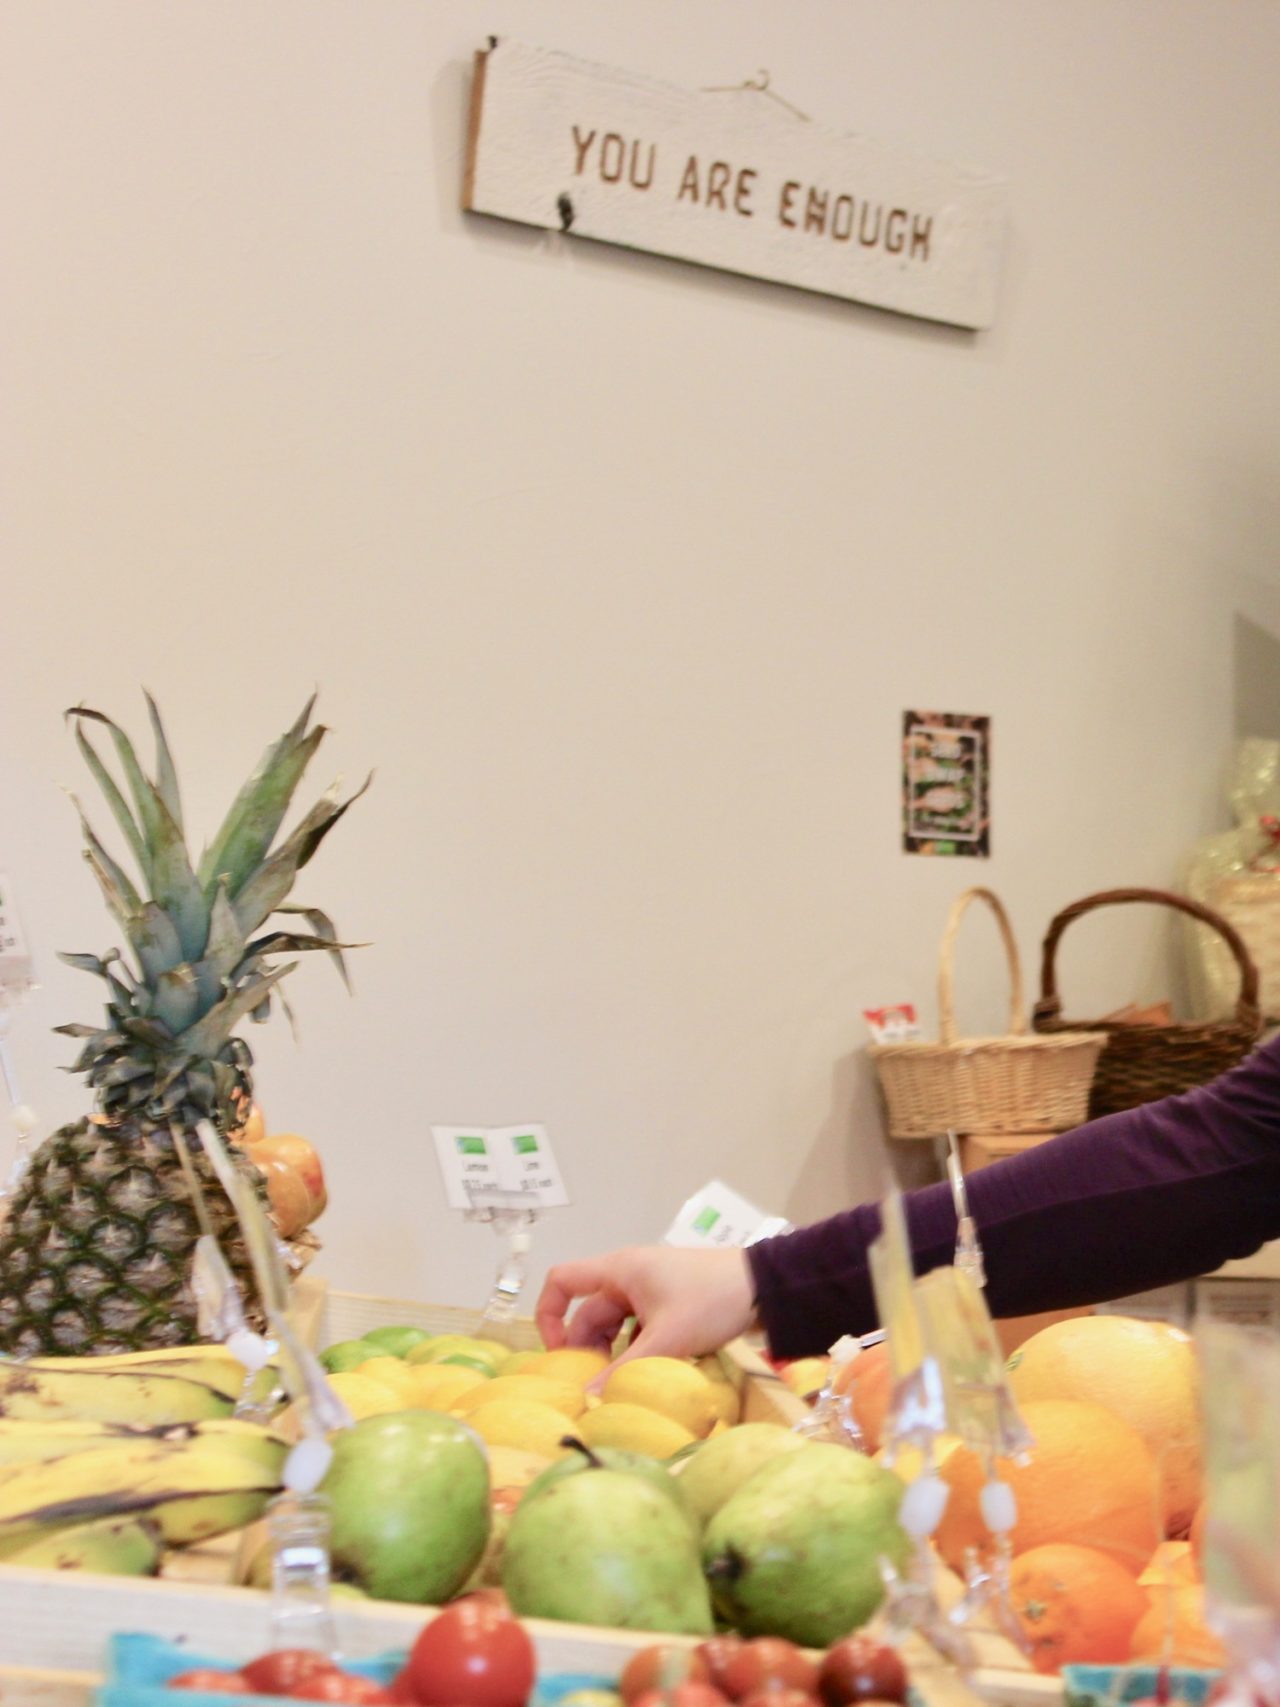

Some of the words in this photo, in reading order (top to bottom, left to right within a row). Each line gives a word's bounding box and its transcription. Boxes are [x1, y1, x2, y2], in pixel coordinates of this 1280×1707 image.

[572, 125, 655, 191] YOU
[677, 155, 757, 216] ARE
[779, 180, 933, 262] ENOUGH
